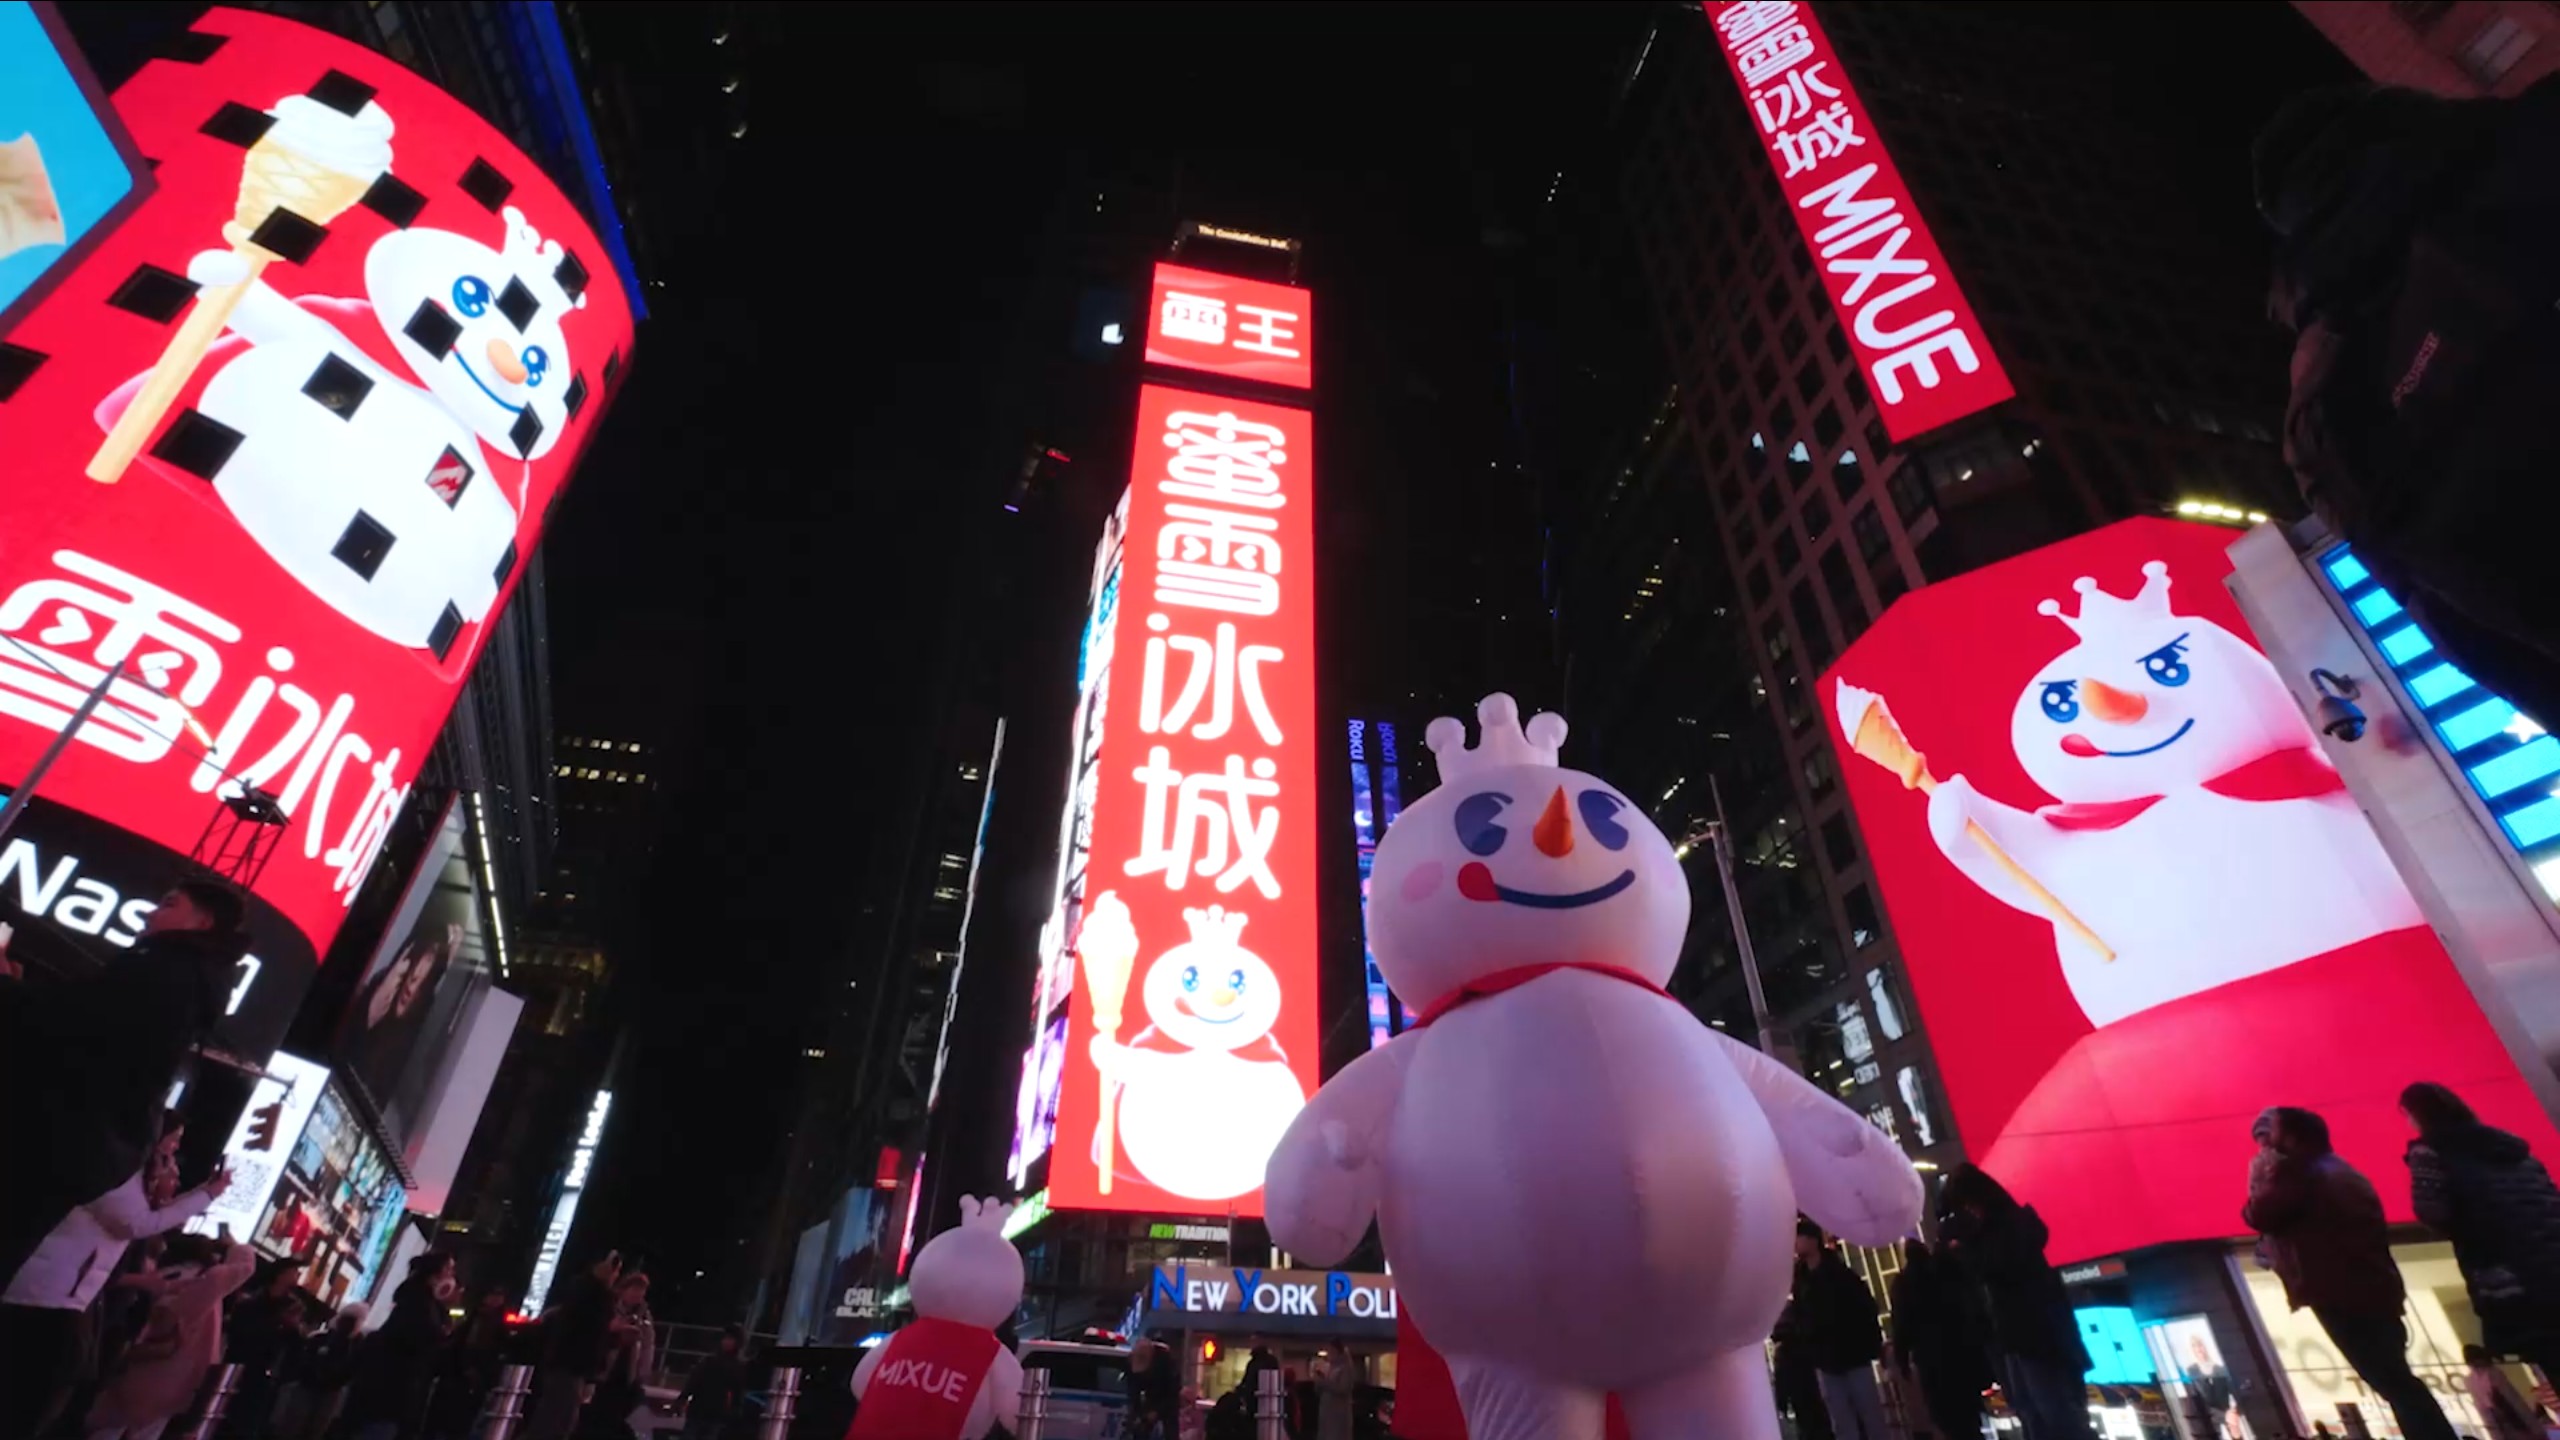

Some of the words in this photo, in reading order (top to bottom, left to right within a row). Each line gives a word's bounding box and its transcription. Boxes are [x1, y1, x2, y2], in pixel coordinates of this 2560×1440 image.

[1799, 162, 1980, 405] MIXUE
[1160, 291, 1301, 359] 雪王
[1123, 410, 1287, 900] 蜜雪冰城
[1152, 1264, 1229, 1313] NEW
[1233, 1267, 1319, 1317] YORK
[875, 1359, 968, 1403] MIXUE
